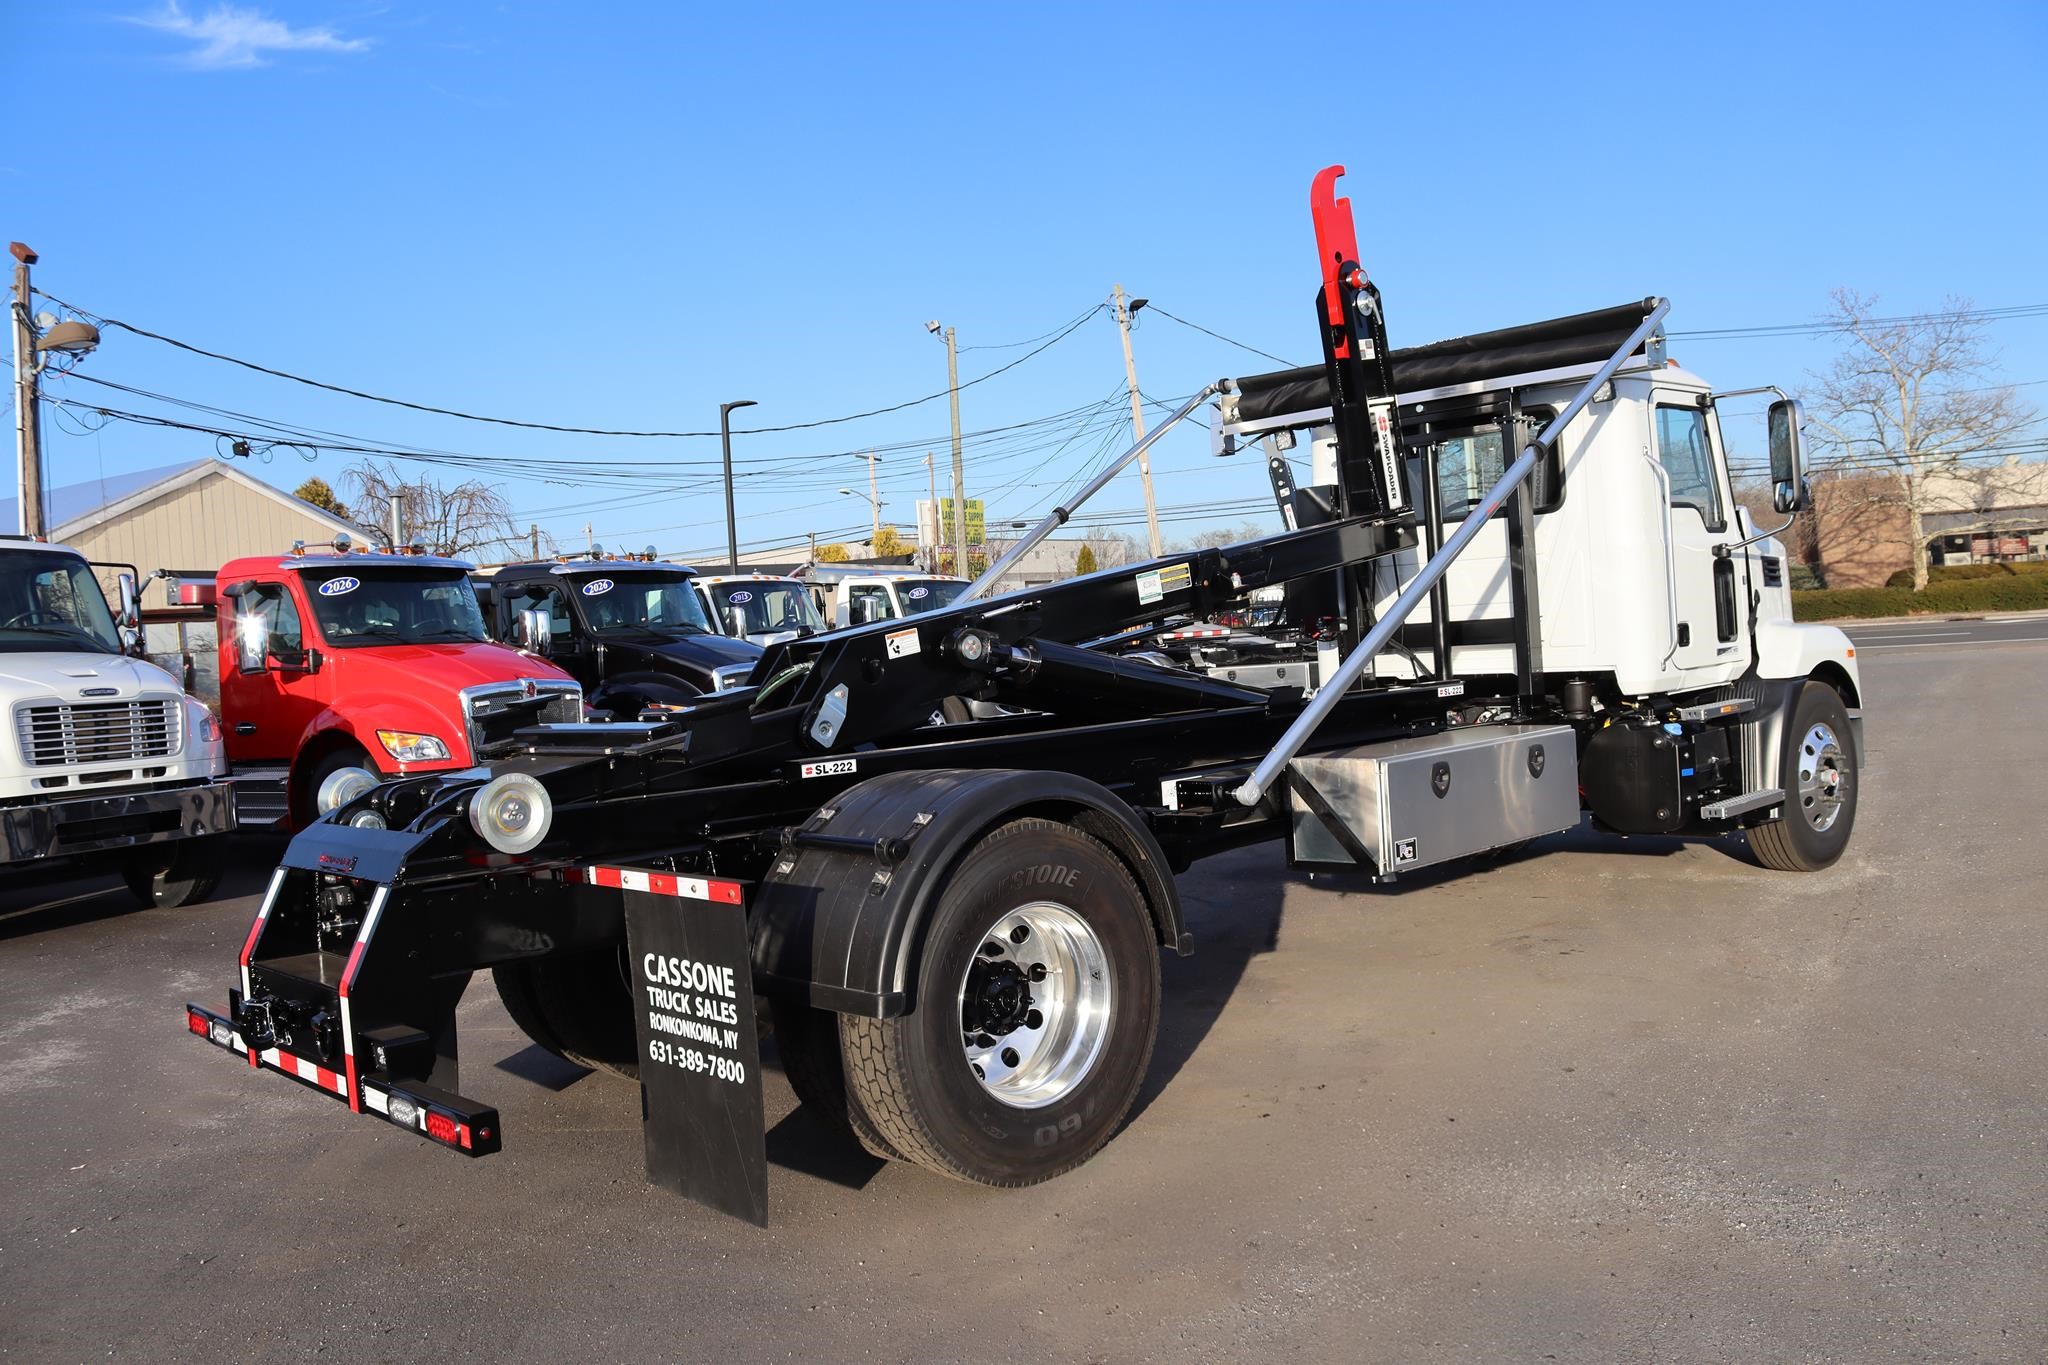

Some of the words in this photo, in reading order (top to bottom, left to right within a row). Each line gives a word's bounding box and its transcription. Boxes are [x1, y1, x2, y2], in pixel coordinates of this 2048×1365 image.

[1382, 433, 1397, 499] SWAPLOADER
[969, 511, 984, 522] SUPPLY
[326, 578, 352, 594] 2026
[588, 579, 608, 594] 2026
[643, 952, 737, 999] CASSONE
[646, 985, 692, 1015] TRUCK
[695, 996, 738, 1025] SALES
[649, 1011, 723, 1049] RONKONKOMA,
[723, 1029, 738, 1050] NY
[649, 1039, 745, 1085] 631-389-7800
